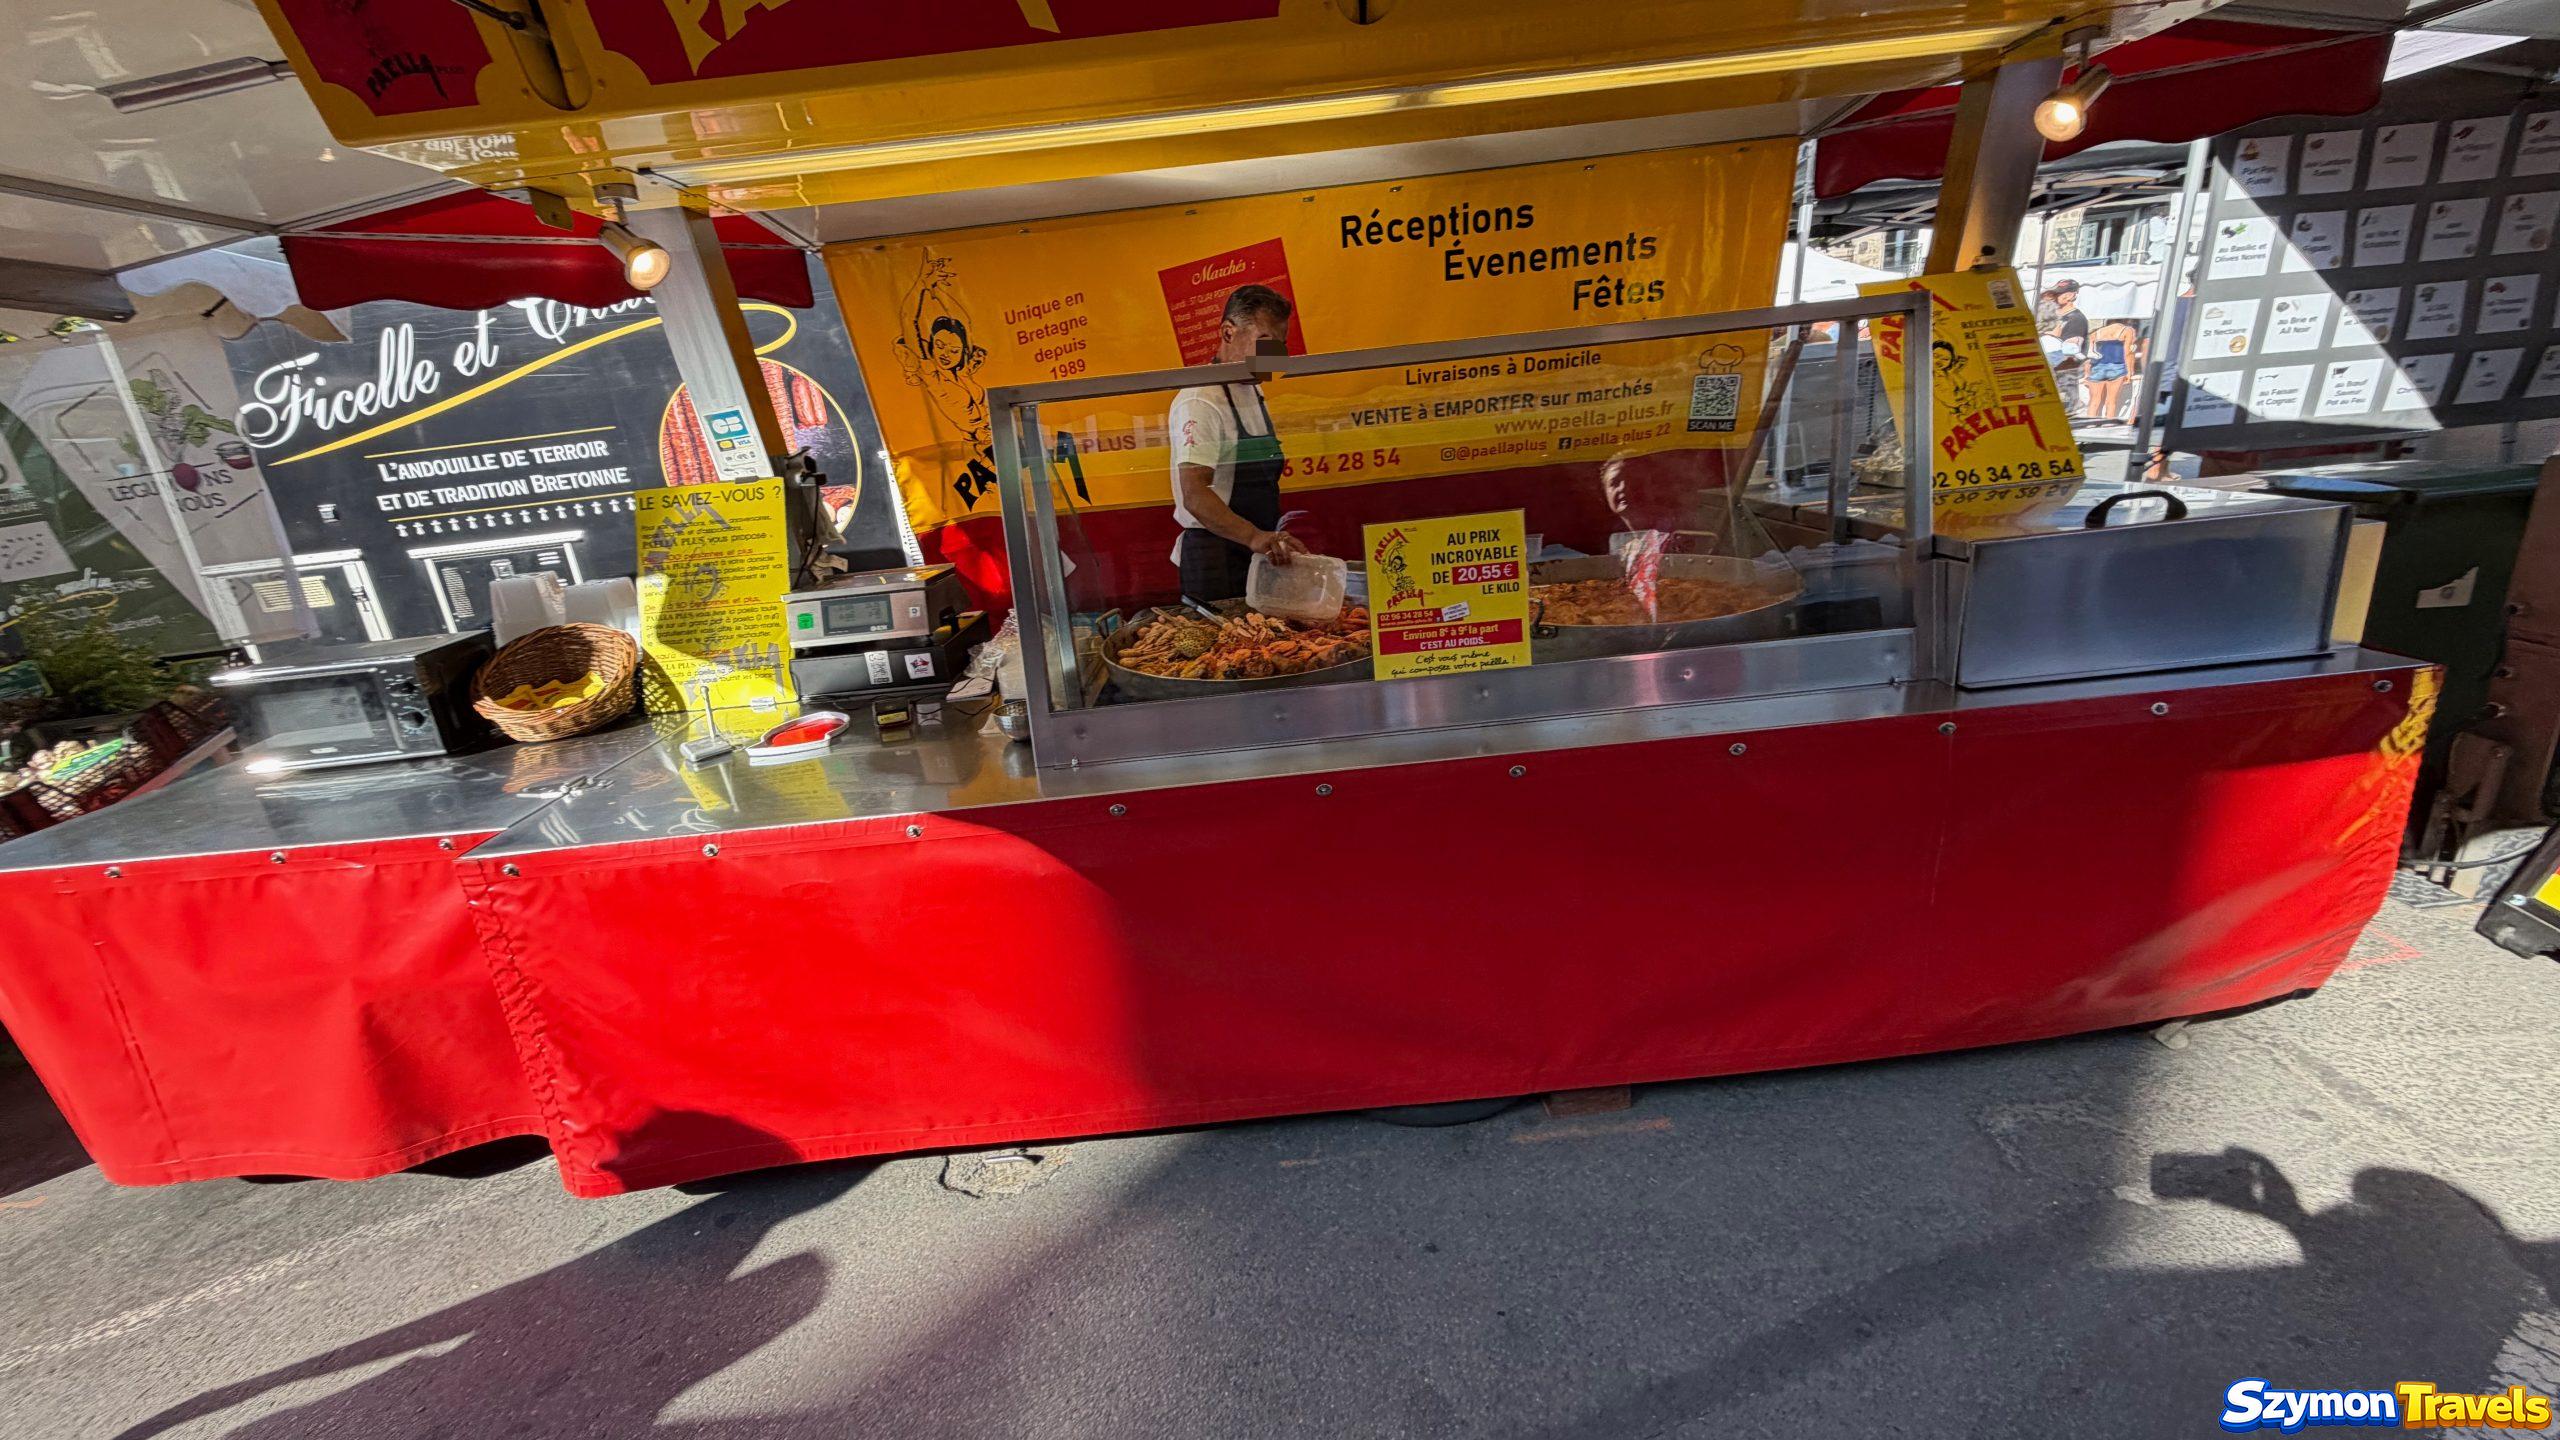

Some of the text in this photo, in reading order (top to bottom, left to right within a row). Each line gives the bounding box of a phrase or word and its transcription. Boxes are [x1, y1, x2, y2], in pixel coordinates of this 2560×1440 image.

[1340, 203, 1535, 248] Réceptions
[1444, 231, 1658, 282] Évenements
[1192, 258, 1246, 286] Marchés
[1573, 274, 1665, 310] Fêtes
[1004, 291, 1085, 326] Unique en
[1016, 313, 1089, 346] Bretagne
[1034, 338, 1087, 364] depuis
[235, 323, 440, 449] Ficelle
[452, 310, 499, 377] et
[1050, 358, 1086, 380] 1989
[1405, 350, 1601, 386] Livraisons à Domicile
[1351, 379, 1654, 427] VENTE à EMPORTER sur marchés
[1494, 401, 1675, 434] www.paella-plus.fr
[1688, 420, 1734, 431] SCAN ME
[1082, 434, 1136, 454] PLUS
[1573, 423, 1671, 450] paella plus 22
[1941, 404, 2048, 463] PAELLA
[378, 440, 610, 482] L'ANDOUILLE DE TERROIR
[1302, 456, 1329, 476] 34
[1338, 452, 1364, 472] 28
[1373, 448, 1400, 468] 54
[1456, 440, 1547, 462] @paellaplus
[1955, 470, 1980, 487] 96
[1987, 465, 2012, 484] 34
[2018, 462, 2042, 480] 28
[2049, 459, 2075, 476] 54
[376, 466, 632, 512] ET DE TRADITION BRETONNE
[640, 486, 781, 510] LE SAVIEZ-VOUS ?
[1373, 528, 1410, 566] PAELLA
[1447, 529, 1500, 546] AU PRIX
[1431, 546, 1519, 566] INCROYABLE
[1432, 571, 1450, 584] DE
[1482, 582, 1520, 595] LE KILO
[1386, 588, 1424, 610] PAELLA
[1403, 629, 1438, 640] Environ
[1451, 628, 1457, 636] à
[1468, 624, 1478, 634] la
[1480, 624, 1499, 636] part
[1420, 640, 1442, 650] C'EST
[1444, 639, 1457, 648] AU
[1391, 667, 1406, 678] qui
[1408, 664, 1452, 676] composez
[1454, 659, 1478, 669] votre
[1438, 654, 1458, 662] vous
[1460, 650, 1490, 659] même
